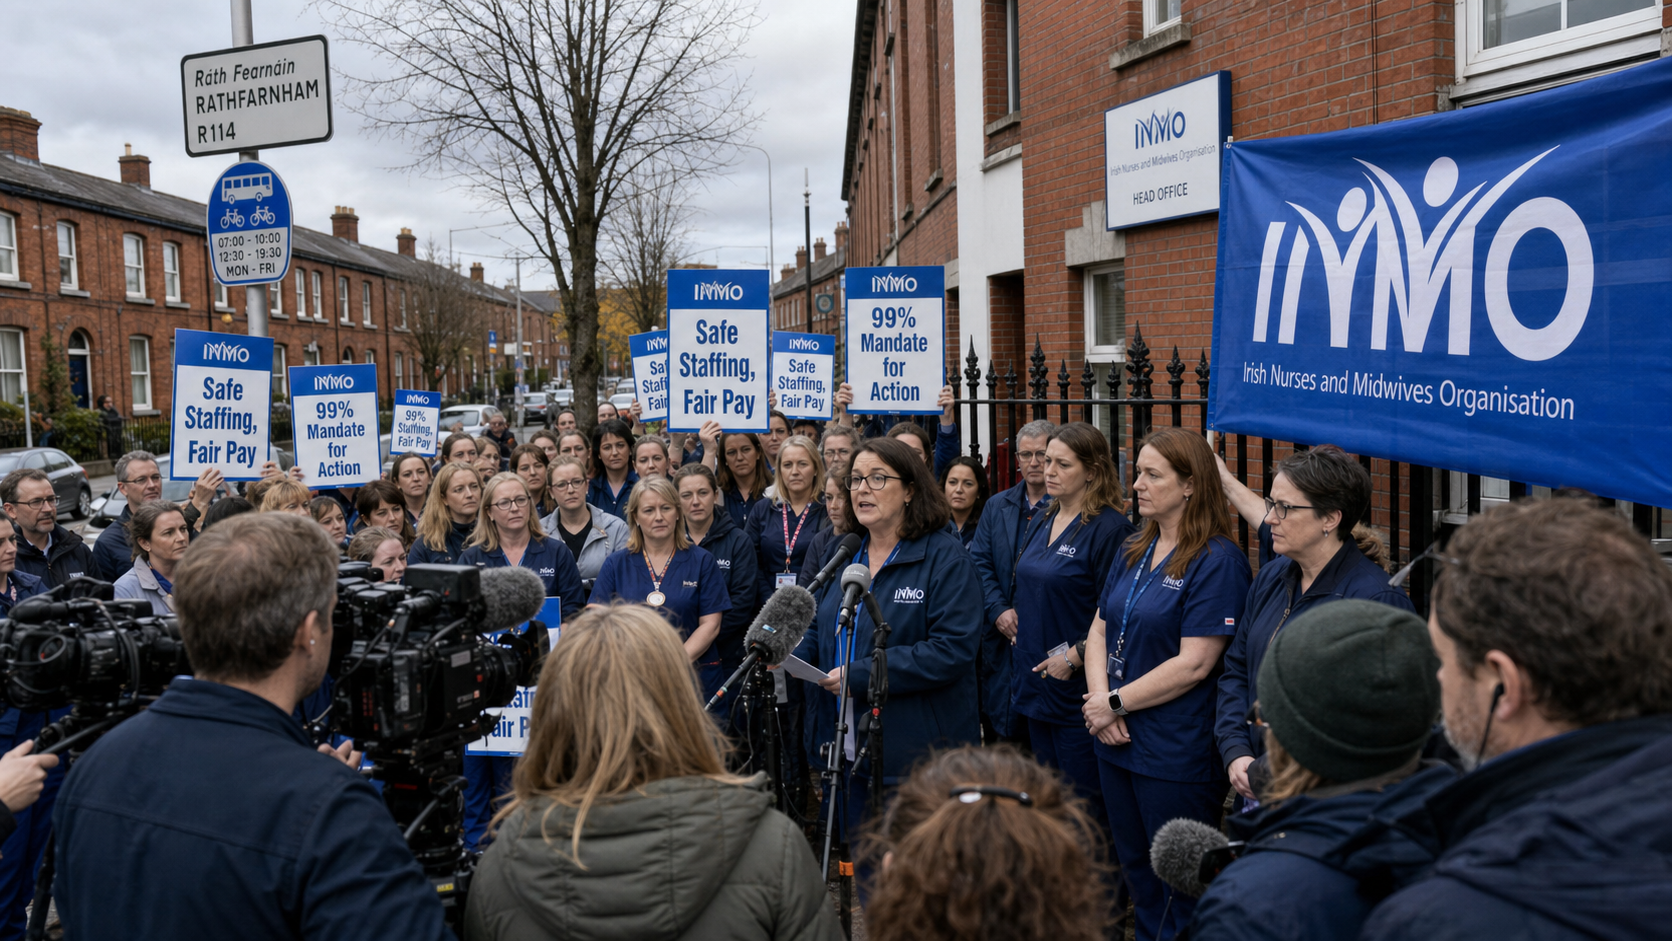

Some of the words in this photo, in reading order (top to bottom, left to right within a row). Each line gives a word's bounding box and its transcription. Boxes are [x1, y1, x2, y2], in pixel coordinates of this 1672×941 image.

[195, 67, 227, 87] Ráth
[233, 58, 295, 82] Fearnáin
[196, 79, 319, 114] RATHFARNHAM
[197, 121, 236, 144] R114
[1135, 107, 1186, 149] INMO
[1140, 157, 1151, 169] and
[1132, 189, 1155, 206] HEAD
[1157, 182, 1188, 201] OFFICE
[218, 235, 244, 248] 07:00
[255, 232, 281, 244] 10:00
[219, 249, 244, 262] 12:30
[255, 247, 281, 259] 19:30
[1252, 144, 1594, 362] INMO
[226, 265, 248, 277] MON
[259, 262, 275, 274] FRI
[694, 280, 743, 300] INMO
[871, 272, 918, 293] INMO
[871, 306, 916, 328] 99%
[696, 319, 738, 344] Safe
[203, 341, 250, 363] INMO
[789, 337, 820, 350] INMO
[860, 332, 928, 353] Mandate
[679, 352, 755, 382] Staffing,
[788, 359, 816, 374] Safe
[883, 356, 906, 377] for
[202, 376, 243, 401] Safe
[314, 373, 354, 390] INMO
[778, 375, 826, 394] Staffing,
[870, 381, 920, 402] Action
[1243, 361, 1267, 385] Irish
[1270, 364, 1316, 392] Nurses
[1320, 370, 1348, 394] and
[1352, 371, 1433, 405] Midwives
[1439, 379, 1575, 421] Organisation
[316, 400, 354, 419] 99%
[684, 389, 717, 414] Fair
[722, 389, 755, 420] Pay
[781, 394, 802, 408] Fair
[804, 394, 824, 412] Pay
[184, 405, 257, 435] Staffing,
[405, 409, 427, 422] 99%
[307, 422, 365, 439] Mandate
[327, 442, 347, 458] for
[398, 435, 414, 447] Fair
[416, 436, 431, 450] Pay
[188, 440, 221, 464] Fair
[226, 440, 257, 468] Pay
[318, 460, 361, 477] Action
[894, 586, 925, 600] INMO
